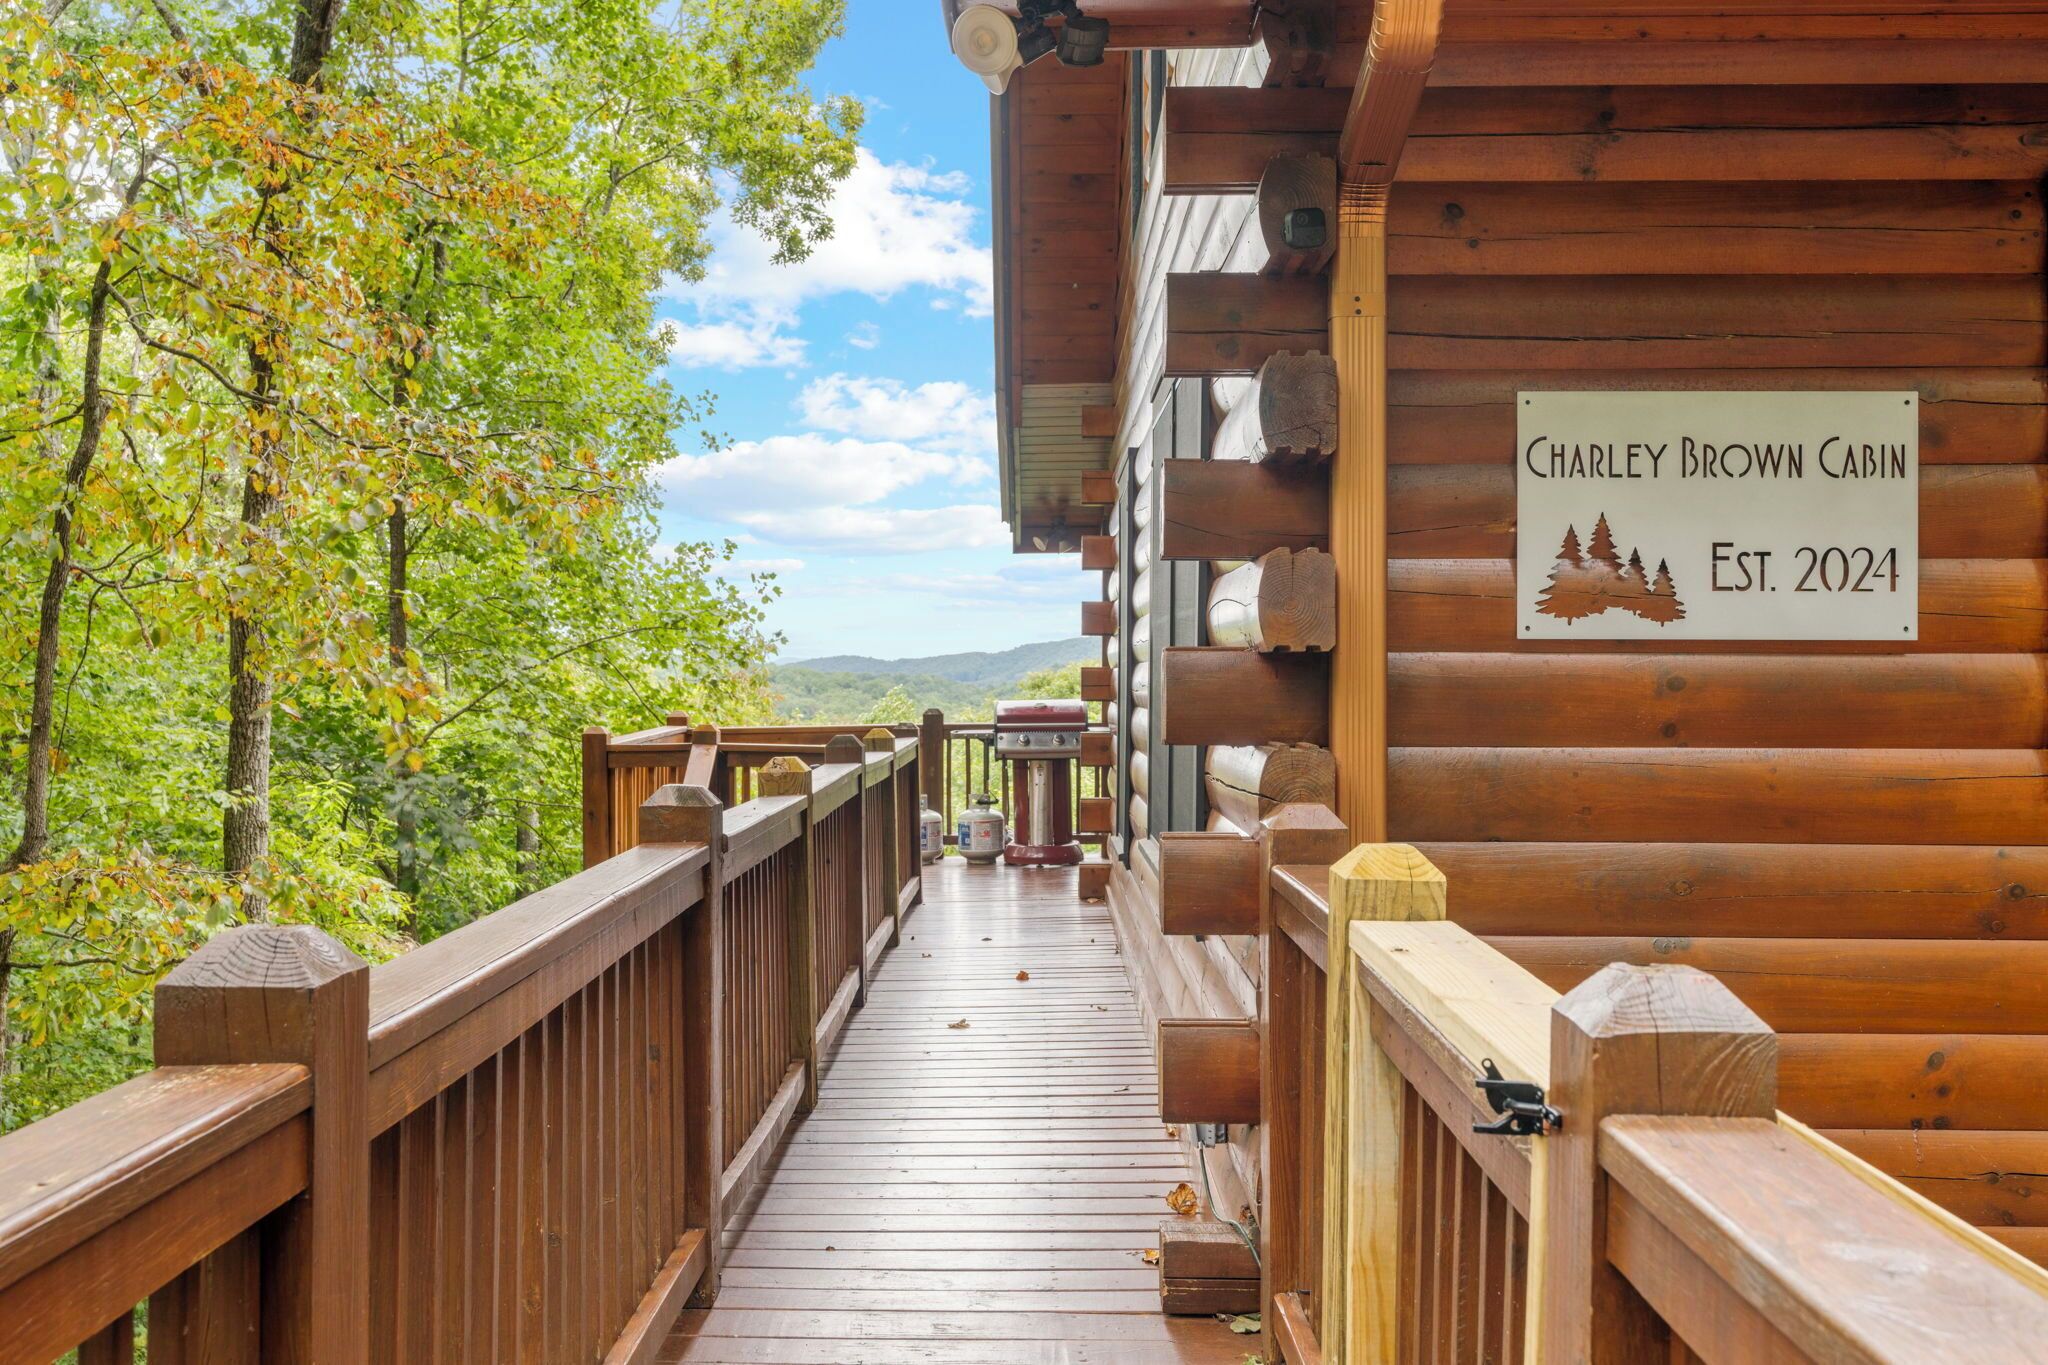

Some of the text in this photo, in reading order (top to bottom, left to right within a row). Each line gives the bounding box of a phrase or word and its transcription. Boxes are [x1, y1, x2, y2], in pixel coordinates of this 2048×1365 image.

[1526, 435, 1906, 479] CHARLEY BROWN CABIN
[1711, 542, 1900, 593] EST. 2024
